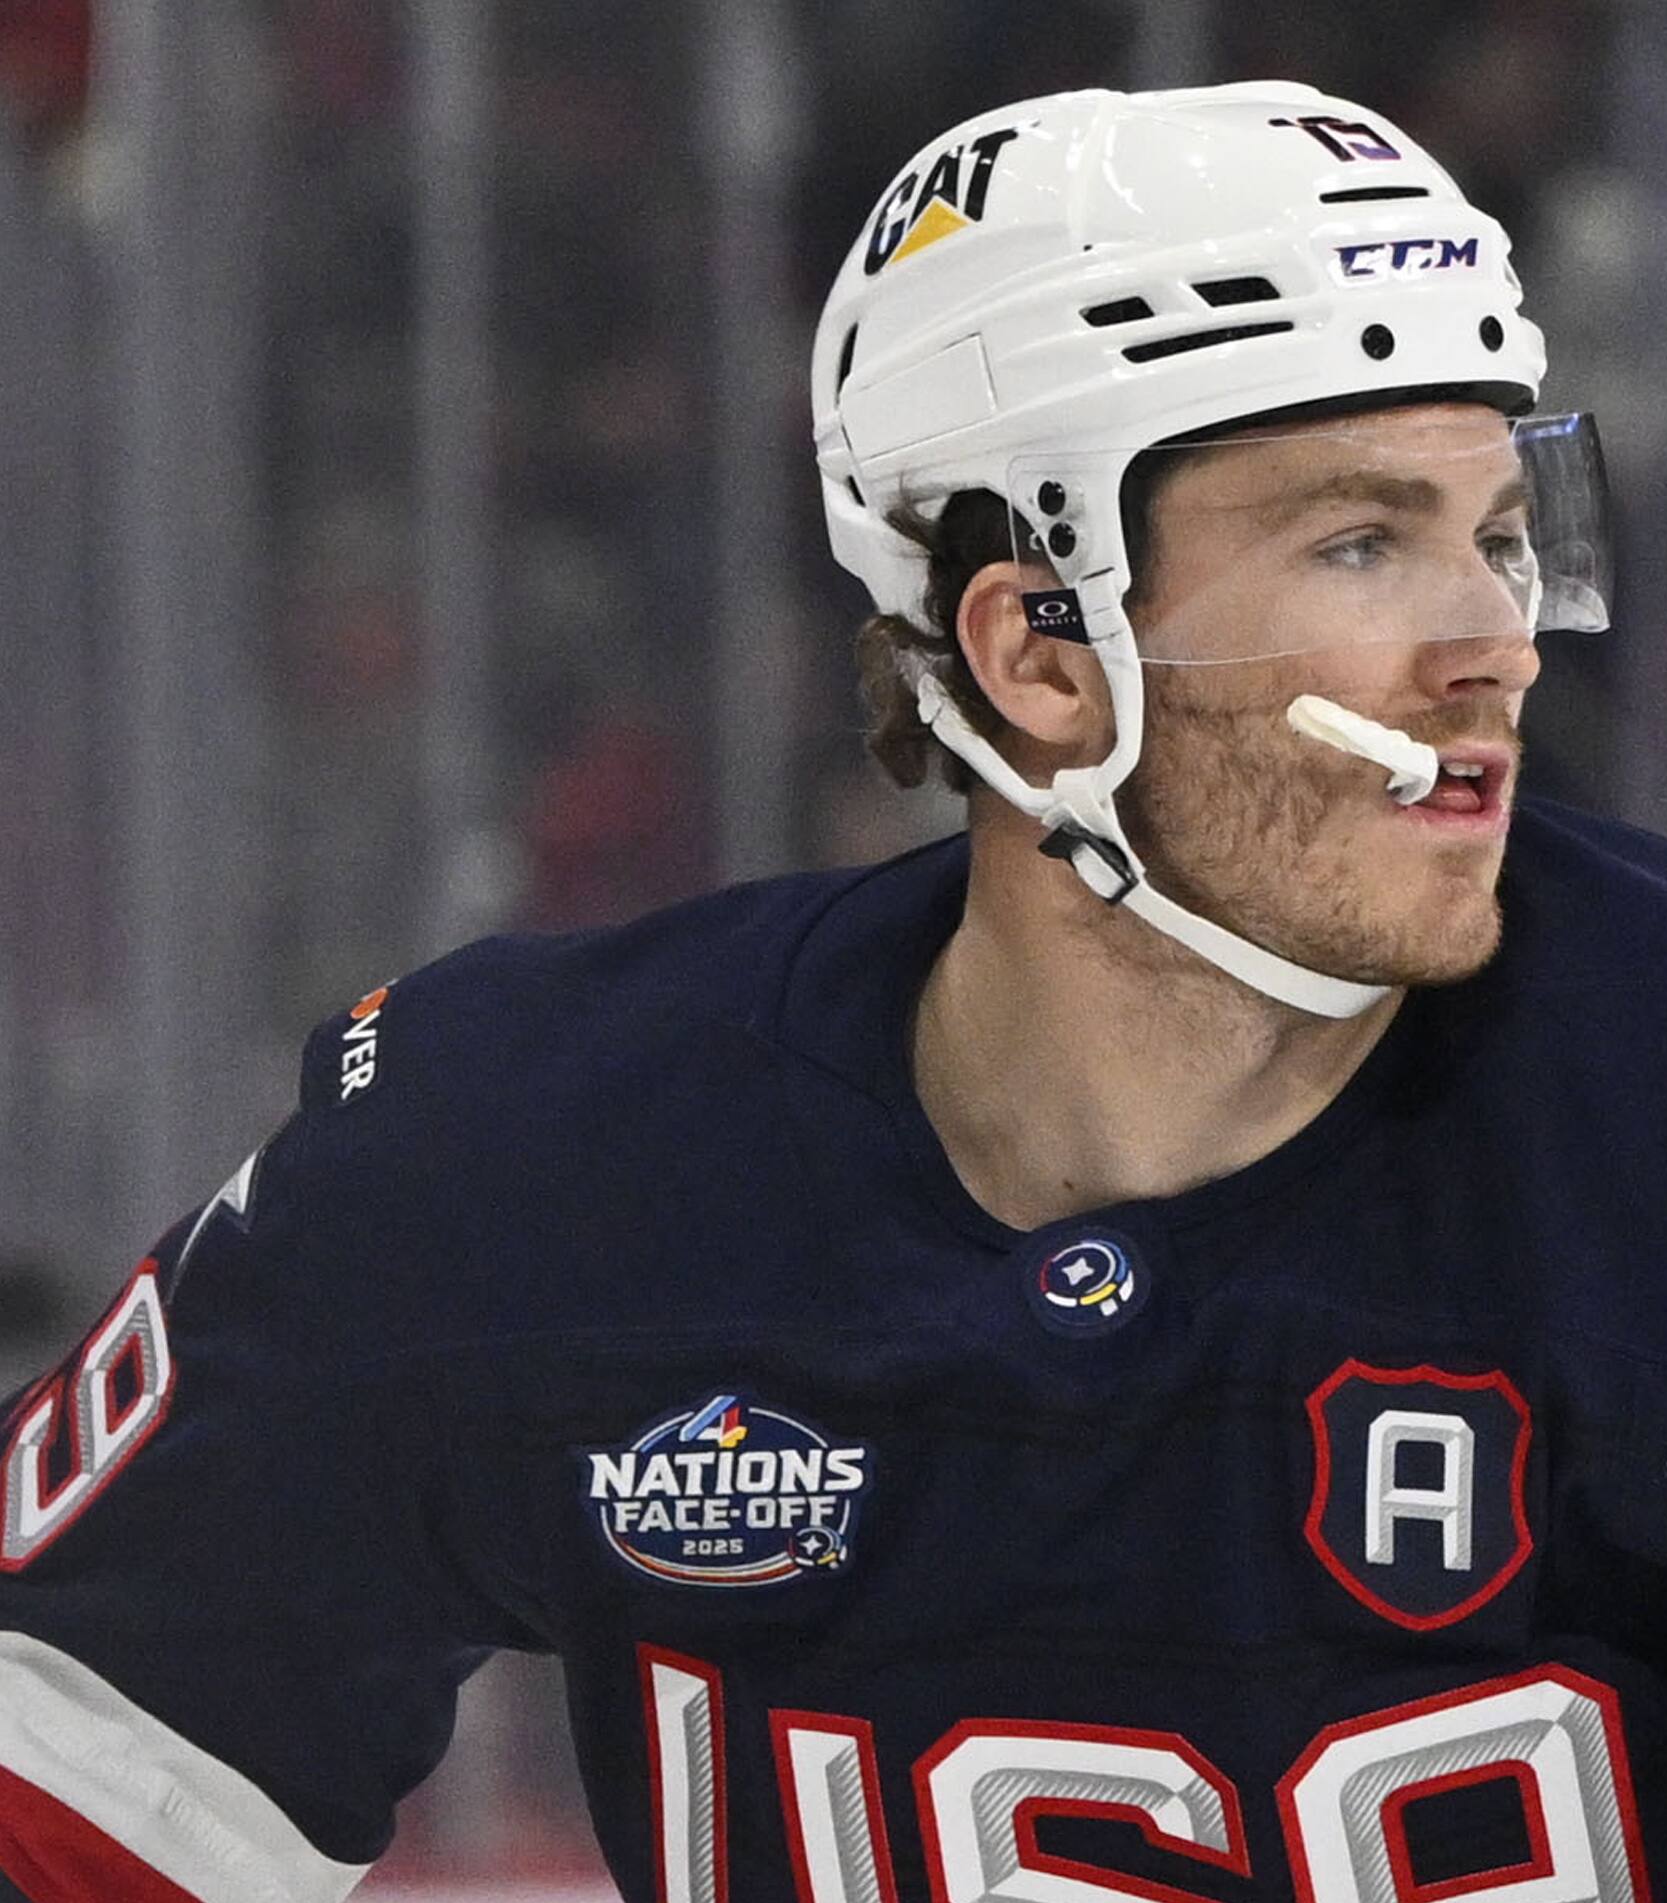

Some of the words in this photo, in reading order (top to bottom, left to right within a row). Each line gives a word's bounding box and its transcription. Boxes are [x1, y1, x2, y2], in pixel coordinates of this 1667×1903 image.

[864, 121, 1030, 276] CAT
[1334, 238, 1479, 278] CCM
[0, 1256, 174, 1573] 9
[679, 1396, 747, 1448] 4
[589, 1448, 865, 1498] NATIONS
[1366, 1410, 1475, 1571] A
[614, 1496, 836, 1533] FACE-OFF
[683, 1539, 743, 1556] 2025
